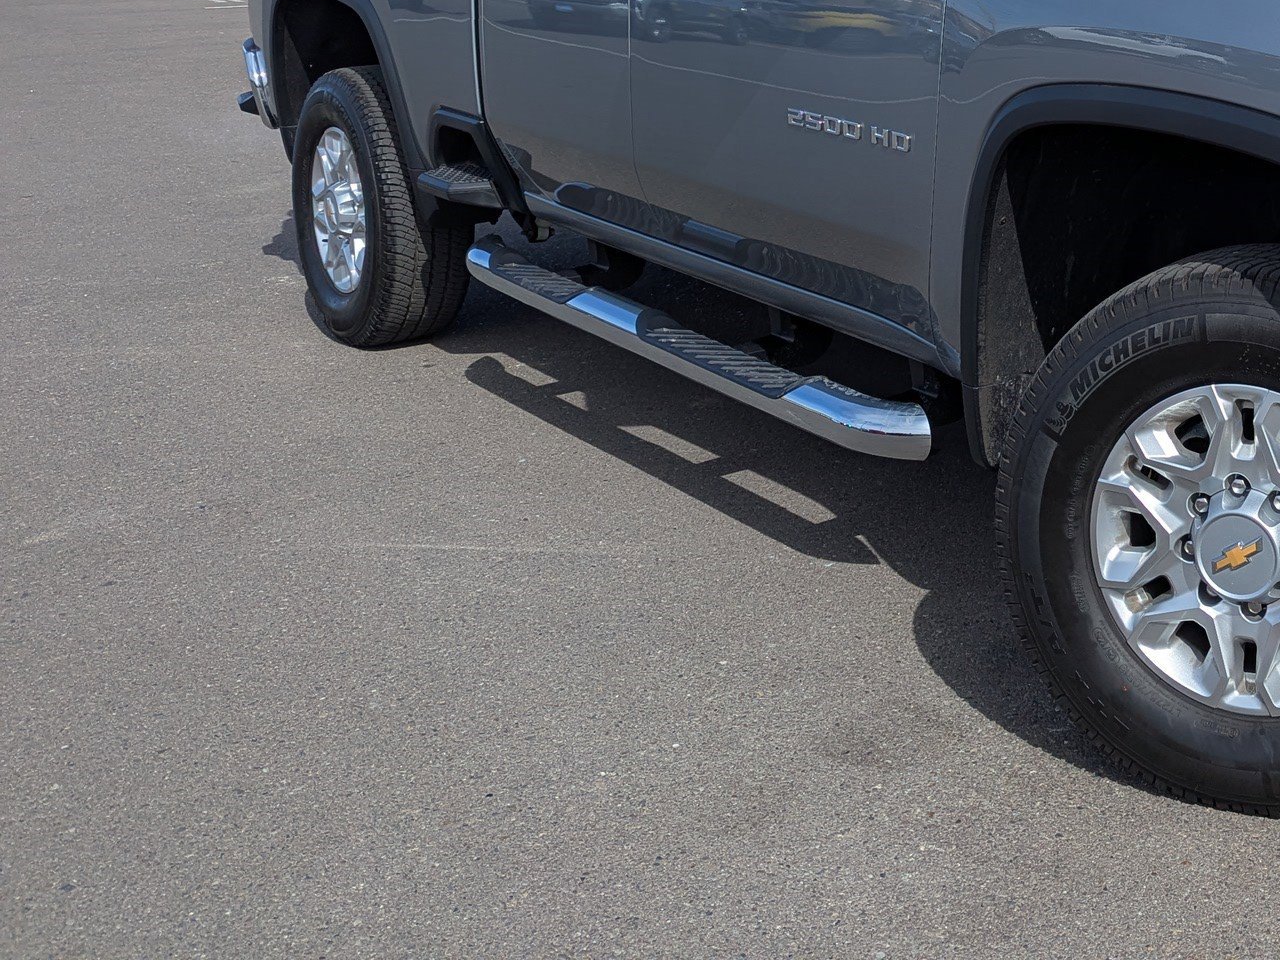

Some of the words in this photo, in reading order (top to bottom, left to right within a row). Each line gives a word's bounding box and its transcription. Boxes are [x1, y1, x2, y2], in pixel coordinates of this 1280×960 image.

[787, 107, 864, 141] 2500
[870, 125, 912, 153] HD
[1067, 314, 1198, 402] MICHELIN
